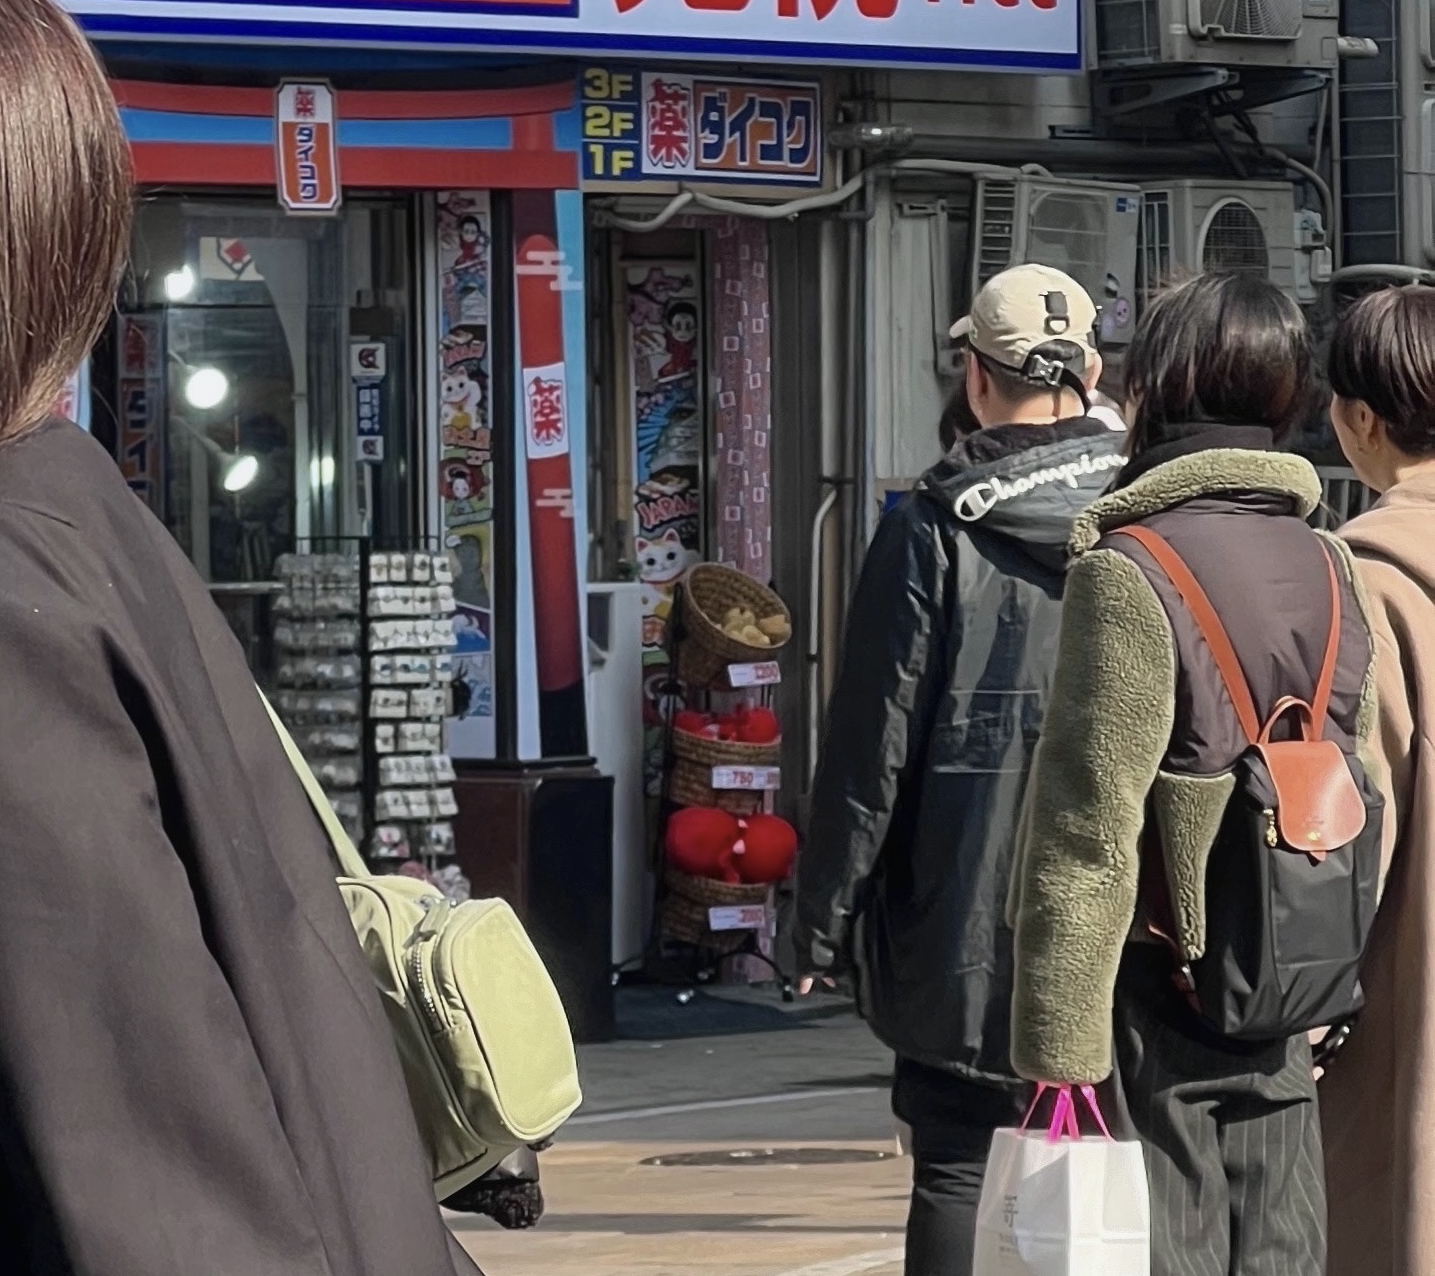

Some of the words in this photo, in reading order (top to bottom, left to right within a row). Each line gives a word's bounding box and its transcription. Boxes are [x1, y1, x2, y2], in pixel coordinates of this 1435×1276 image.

[583, 68, 634, 99] 3F
[584, 105, 635, 138] 2F
[647, 77, 690, 168] 薬
[699, 89, 814, 167] ダイコク
[296, 125, 319, 201] ダイコク
[588, 143, 635, 176] 1F
[528, 375, 567, 447] 薬
[954, 453, 1129, 522] Champion
